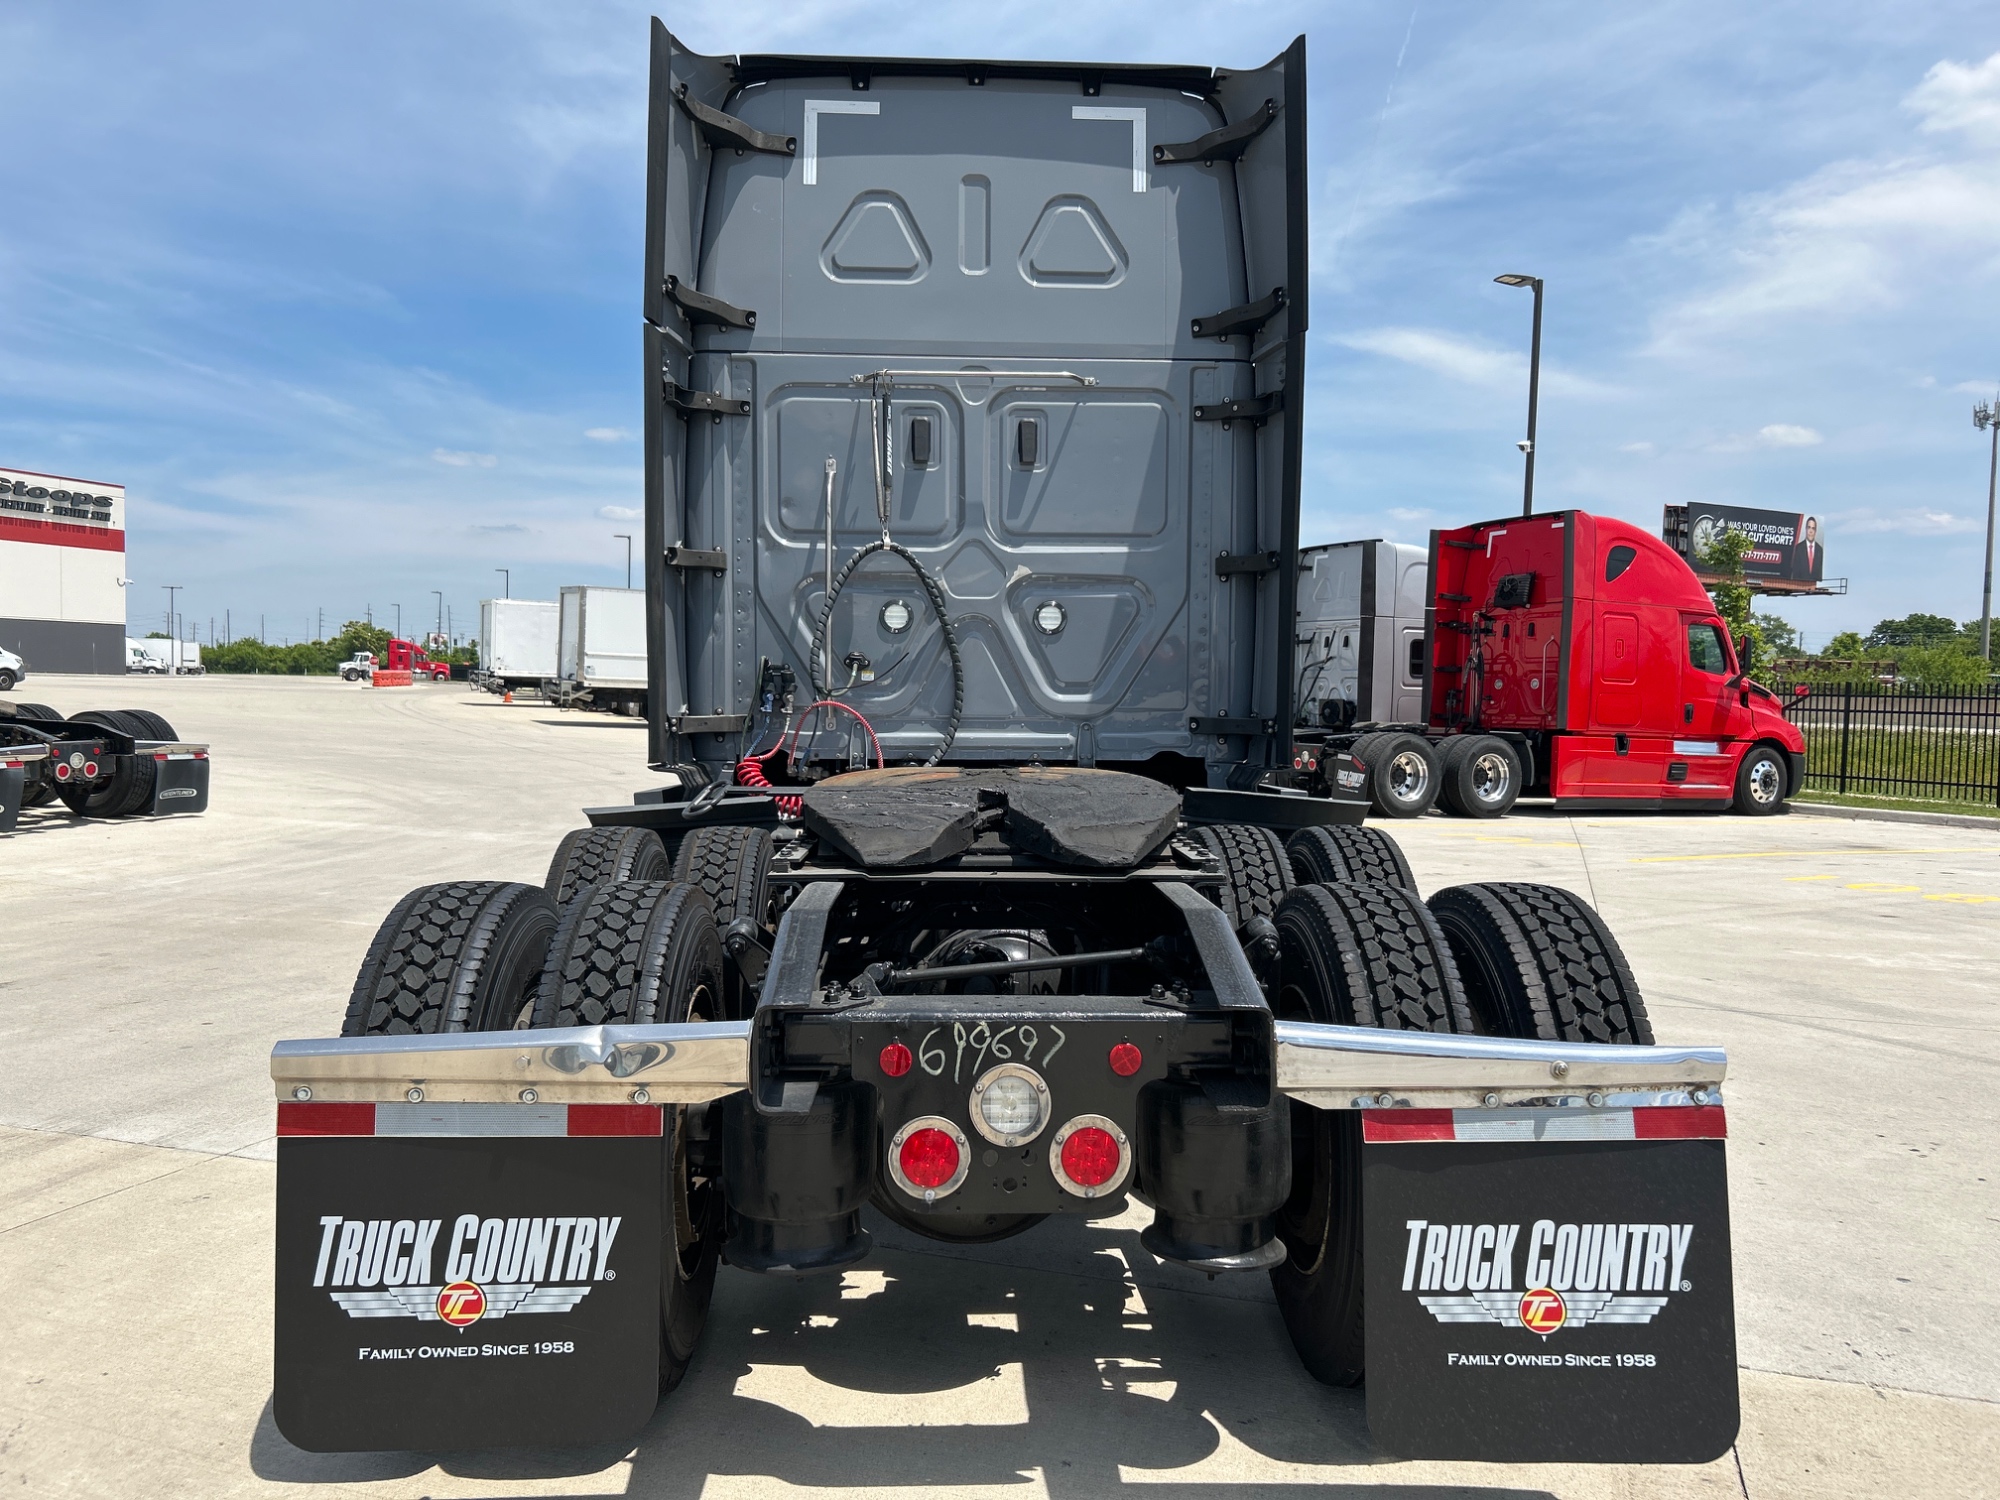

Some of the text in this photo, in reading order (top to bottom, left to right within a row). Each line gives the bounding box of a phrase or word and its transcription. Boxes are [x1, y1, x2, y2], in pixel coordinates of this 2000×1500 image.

[1727, 521, 1741, 530] WAS
[1742, 522, 1758, 531] YOUR
[1758, 524, 1777, 533] LOVED
[1748, 531, 1764, 543] CUT
[1764, 534, 1794, 546] SHORT?
[313, 1215, 442, 1287] TRUCK
[444, 1213, 622, 1284] COUNTRY
[1401, 1220, 1520, 1291] TRUCK
[1525, 1219, 1694, 1292] COUNTRY
[358, 1341, 575, 1360] FAMILY OWNED SINCE 1958
[1447, 1353, 1656, 1367] FAMILY OWNED SINCE 1958
